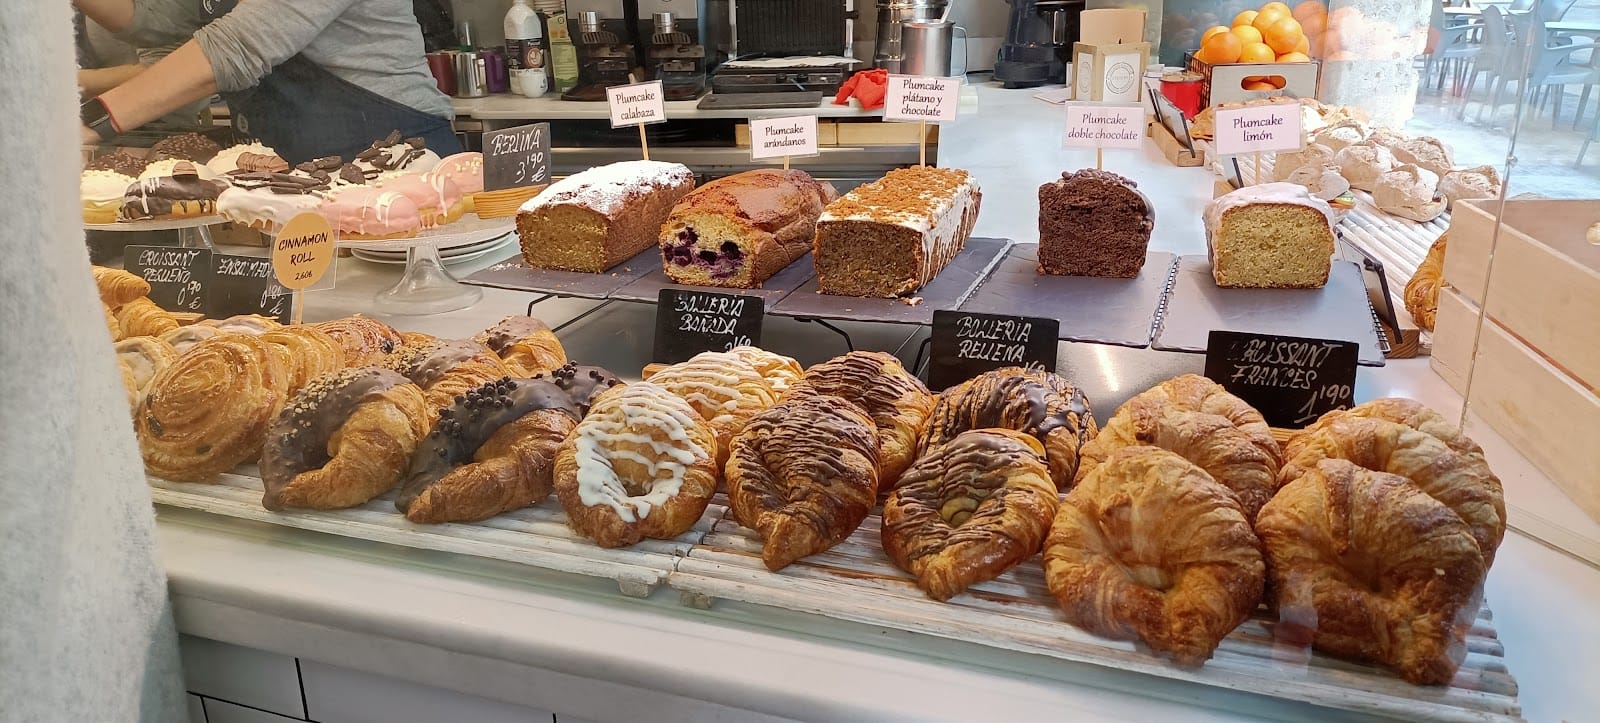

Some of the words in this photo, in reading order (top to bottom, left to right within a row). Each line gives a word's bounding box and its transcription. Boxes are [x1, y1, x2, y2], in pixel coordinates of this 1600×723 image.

[902, 78, 945, 92] Plumcake
[615, 91, 656, 106] Plumcake
[901, 90, 935, 104] plátano
[935, 95, 943, 106] y
[620, 107, 656, 121] calabaza
[901, 104, 942, 117] chocolate
[1081, 112, 1127, 125] Plumcake
[1233, 114, 1284, 129] Plumcake
[764, 125, 804, 137] Plumcake
[1067, 128, 1094, 140] doble
[1095, 128, 1138, 141] chocolate
[1242, 129, 1274, 143] limón
[763, 135, 807, 149] arándanos
[278, 232, 329, 251] CINNAMON
[290, 251, 316, 266] ROLL
[958, 340, 1025, 363] RELLENA
